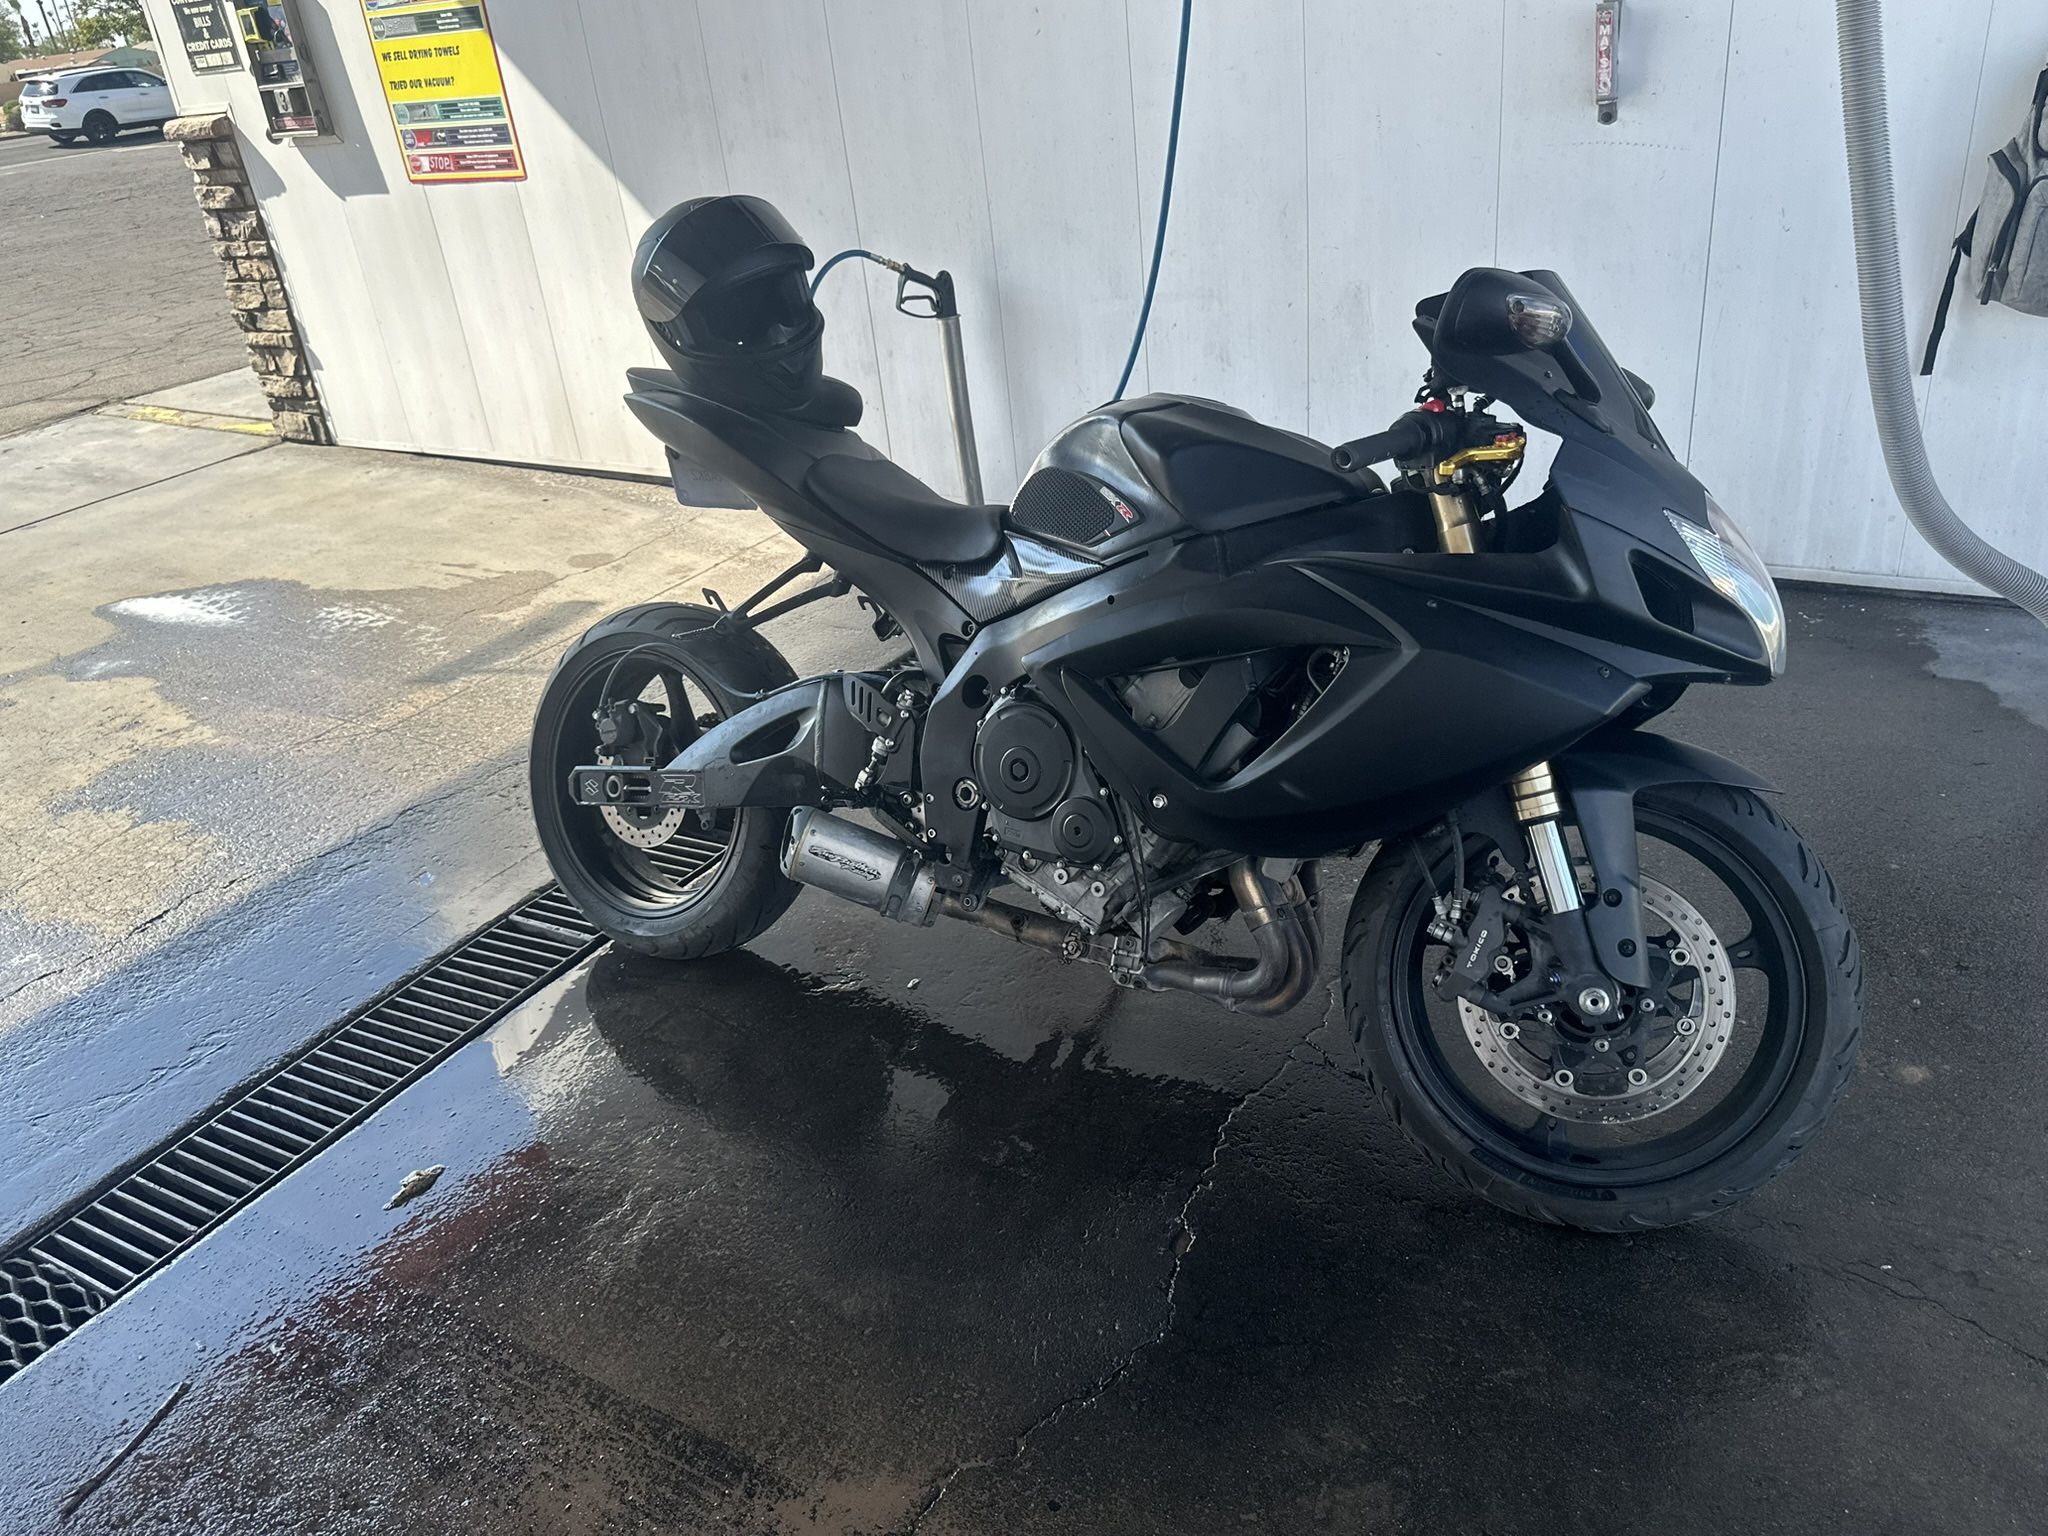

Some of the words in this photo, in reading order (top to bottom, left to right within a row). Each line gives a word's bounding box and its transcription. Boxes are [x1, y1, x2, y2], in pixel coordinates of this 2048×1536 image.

[193, 16, 211, 28] BILLS
[186, 40, 210, 52] CREDIT
[210, 38, 233, 49] CARDS
[382, 52, 392, 62] WE
[393, 50, 408, 61] SELL
[408, 48, 433, 59] DRYING
[434, 45, 460, 57] TOWELS
[389, 80, 408, 90] TRIED
[409, 79, 423, 89] OUR
[424, 76, 455, 88] VACUUM?
[279, 91, 289, 112] 3
[430, 156, 450, 170] STOP
[1466, 929, 1488, 968] TOKICO
